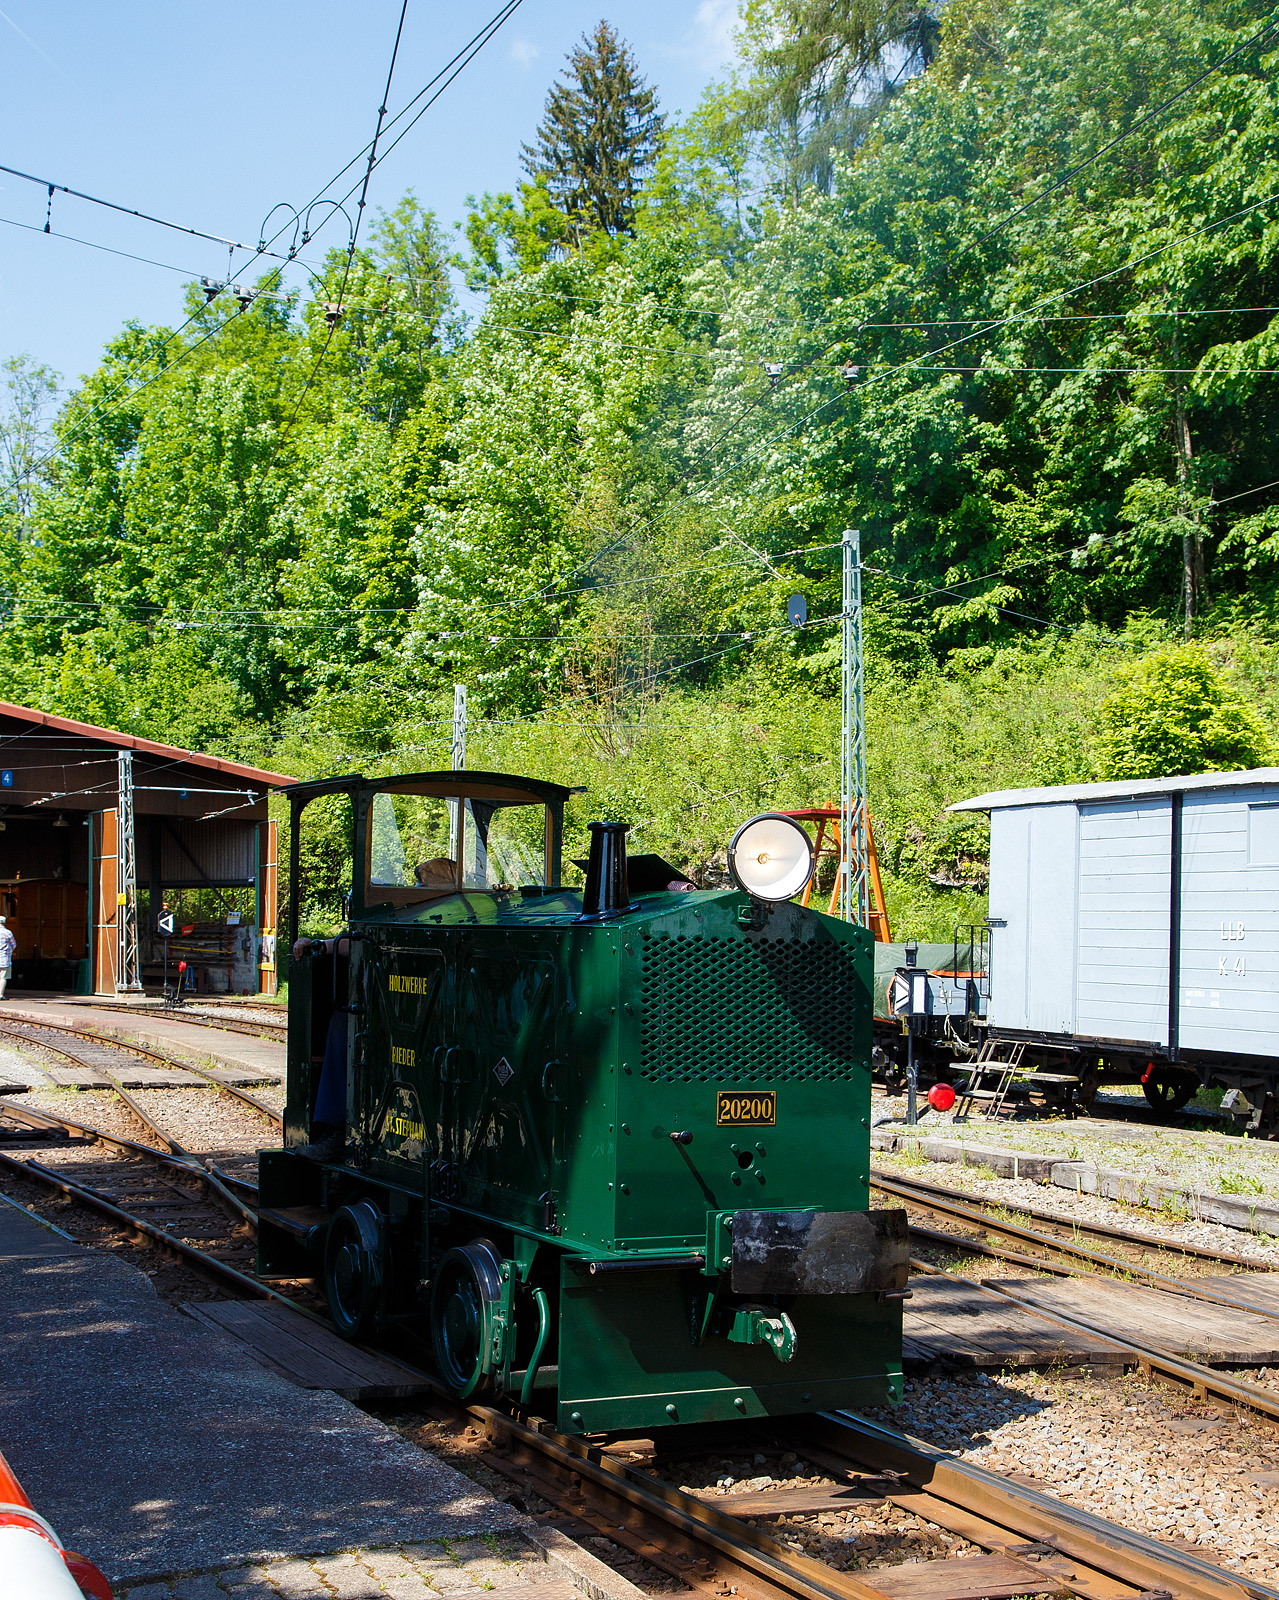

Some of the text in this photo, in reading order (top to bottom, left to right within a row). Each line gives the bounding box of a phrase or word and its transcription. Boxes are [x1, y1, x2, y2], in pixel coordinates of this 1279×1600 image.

[3, 773, 10, 784] 4
[1220, 921, 1245, 941] LLB
[1218, 956, 1246, 977] K 41
[388, 974, 428, 995] HOLZWERKE
[391, 1045, 416, 1067] RIEDER
[720, 1098, 772, 1120] 20200
